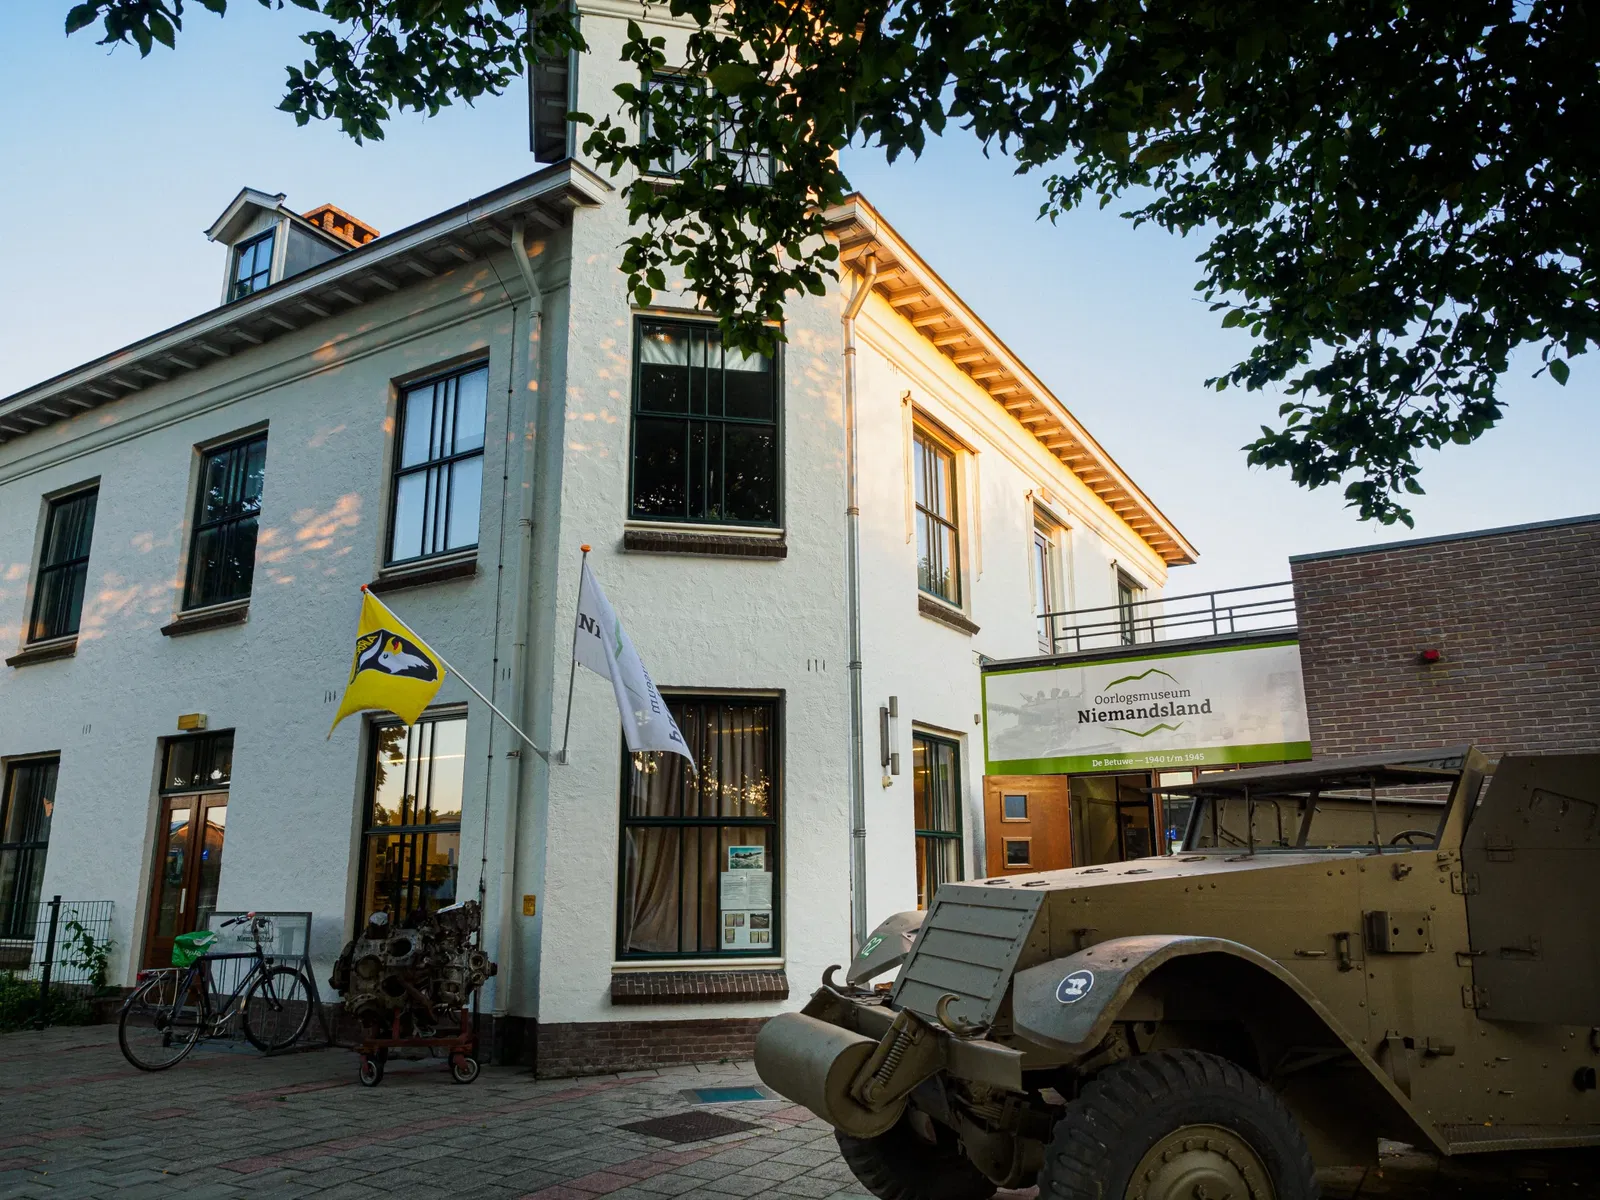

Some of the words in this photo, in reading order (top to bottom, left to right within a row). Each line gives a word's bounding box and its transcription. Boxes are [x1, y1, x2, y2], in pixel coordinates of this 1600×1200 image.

[1094, 689, 1191, 705] Oorlogsmuseum
[1077, 699, 1212, 724] Niemandsland
[1092, 759, 1103, 767] De
[1104, 757, 1134, 767] Betuwe
[1145, 755, 1165, 765] 1940
[1166, 755, 1183, 763] t/m
[1184, 753, 1205, 762] 1945
[861, 937, 882, 956] 62
